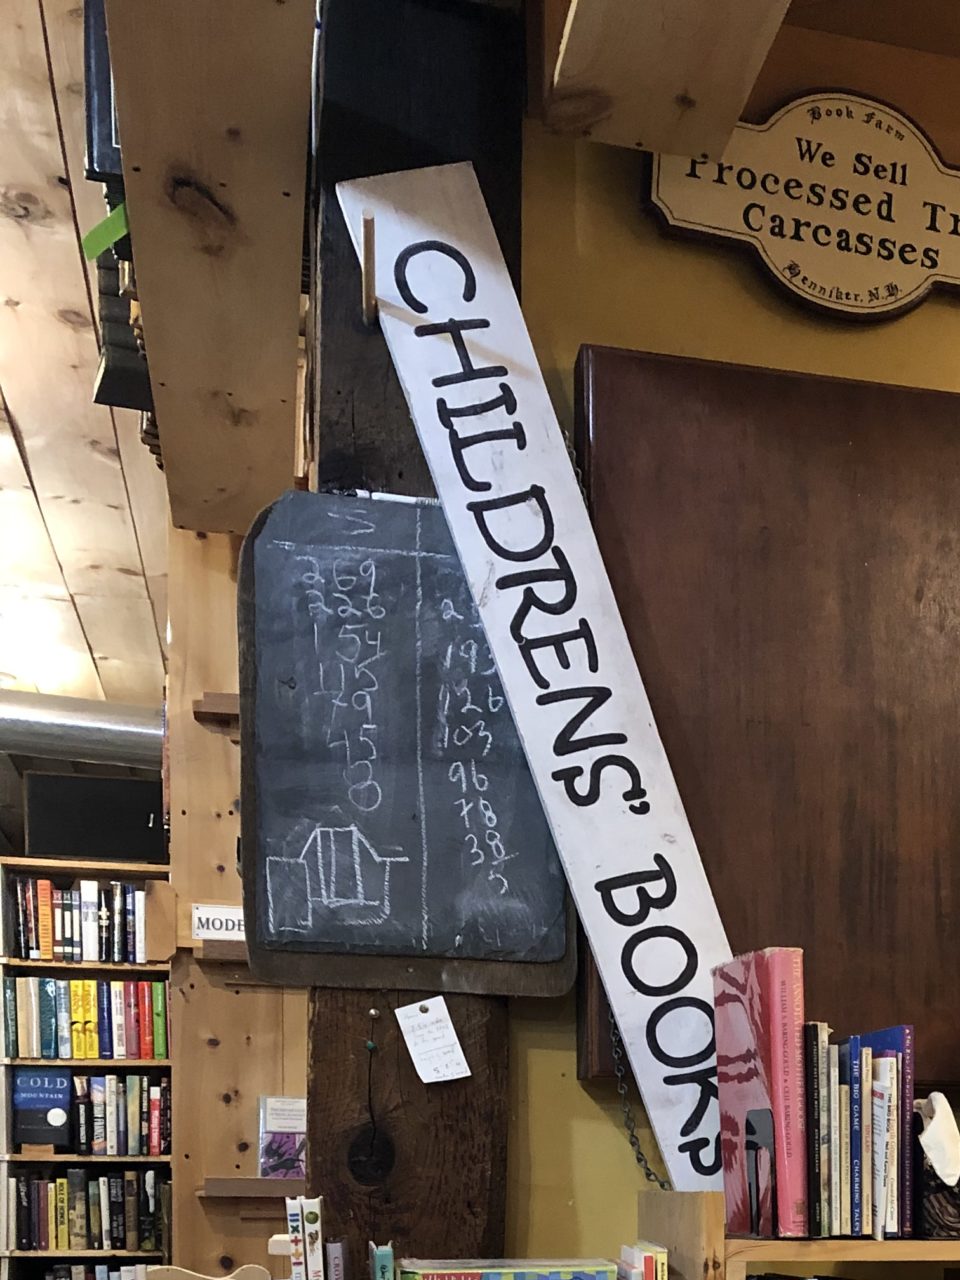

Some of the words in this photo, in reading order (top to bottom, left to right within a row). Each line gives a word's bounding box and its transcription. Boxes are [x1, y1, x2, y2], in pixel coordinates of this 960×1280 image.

[807, 105, 854, 124] Book
[862, 111, 905, 141] Farm
[795, 137, 836, 168] We
[853, 153, 909, 186] Sell
[743, 202, 940, 269] Carcasses
[595, 853, 722, 1178] BOOKS
[17, 1077, 67, 1088] COLD
